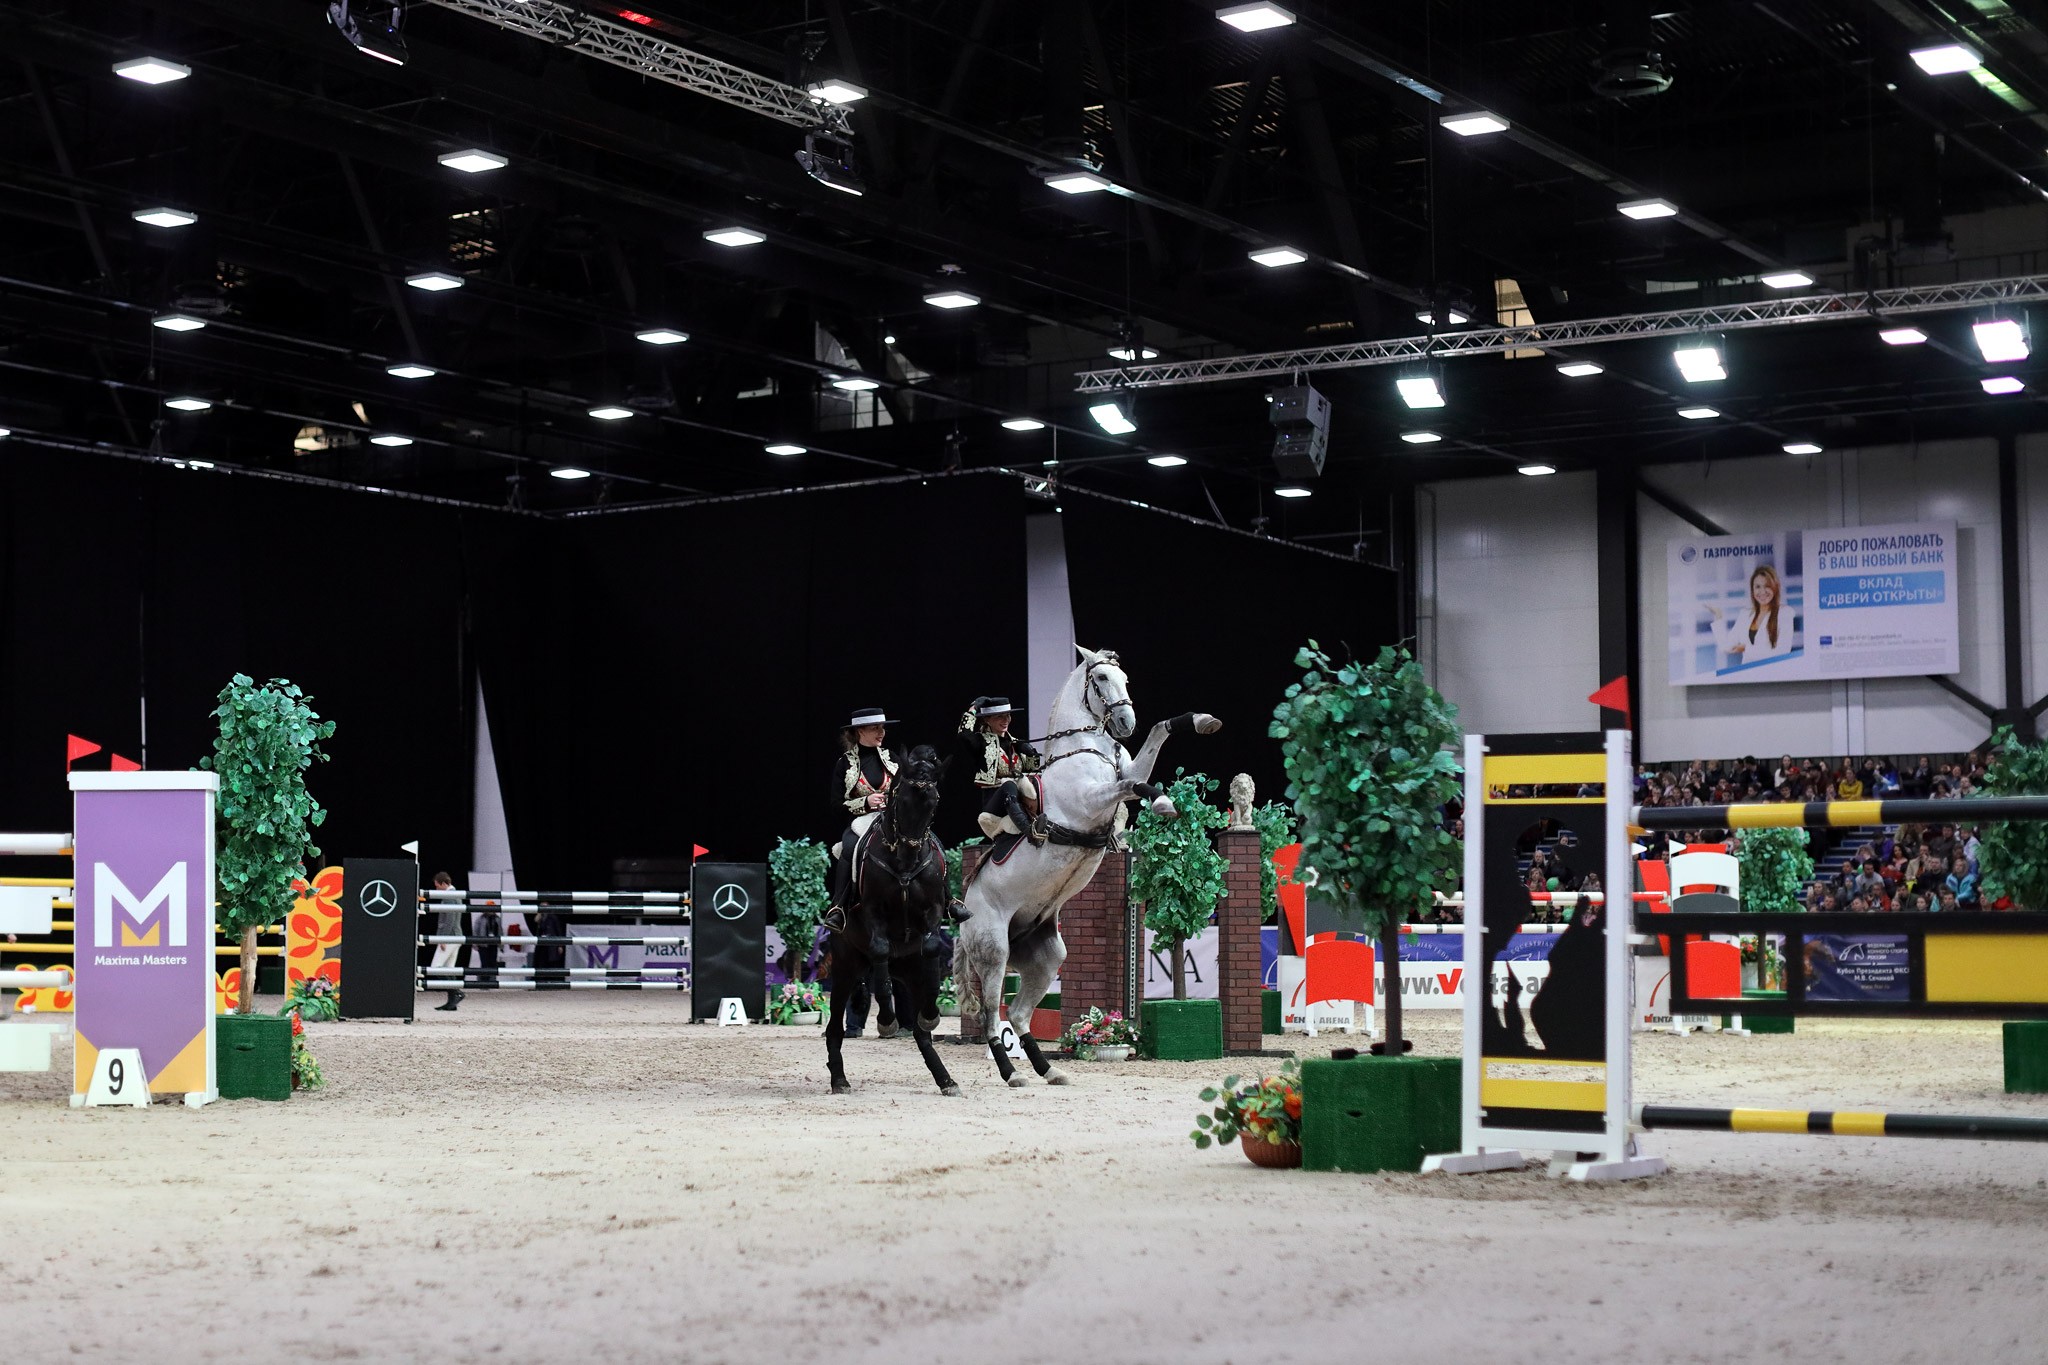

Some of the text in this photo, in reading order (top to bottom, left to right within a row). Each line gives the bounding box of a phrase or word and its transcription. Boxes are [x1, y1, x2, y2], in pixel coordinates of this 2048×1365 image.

[1703, 544, 1774, 559] ГАЗПРОМБАНК
[1818, 533, 1943, 556] ДОБРО ПОЖАЛОВАТЬ
[1819, 550, 1944, 570] В ВАШ НОВЫЙ БАНК
[1859, 577, 1904, 590] ВКЛАД
[1821, 588, 1944, 607] «ДВЕРИ ОТКРЫТЫ»
[94, 955, 187, 966] Maxima Masters
[1836, 967, 1855, 975] Кубок
[1856, 967, 1892, 975] Президента
[729, 1002, 738, 1021] 2
[1319, 1016, 1351, 1025] ARENA
[108, 1058, 124, 1095] 9
